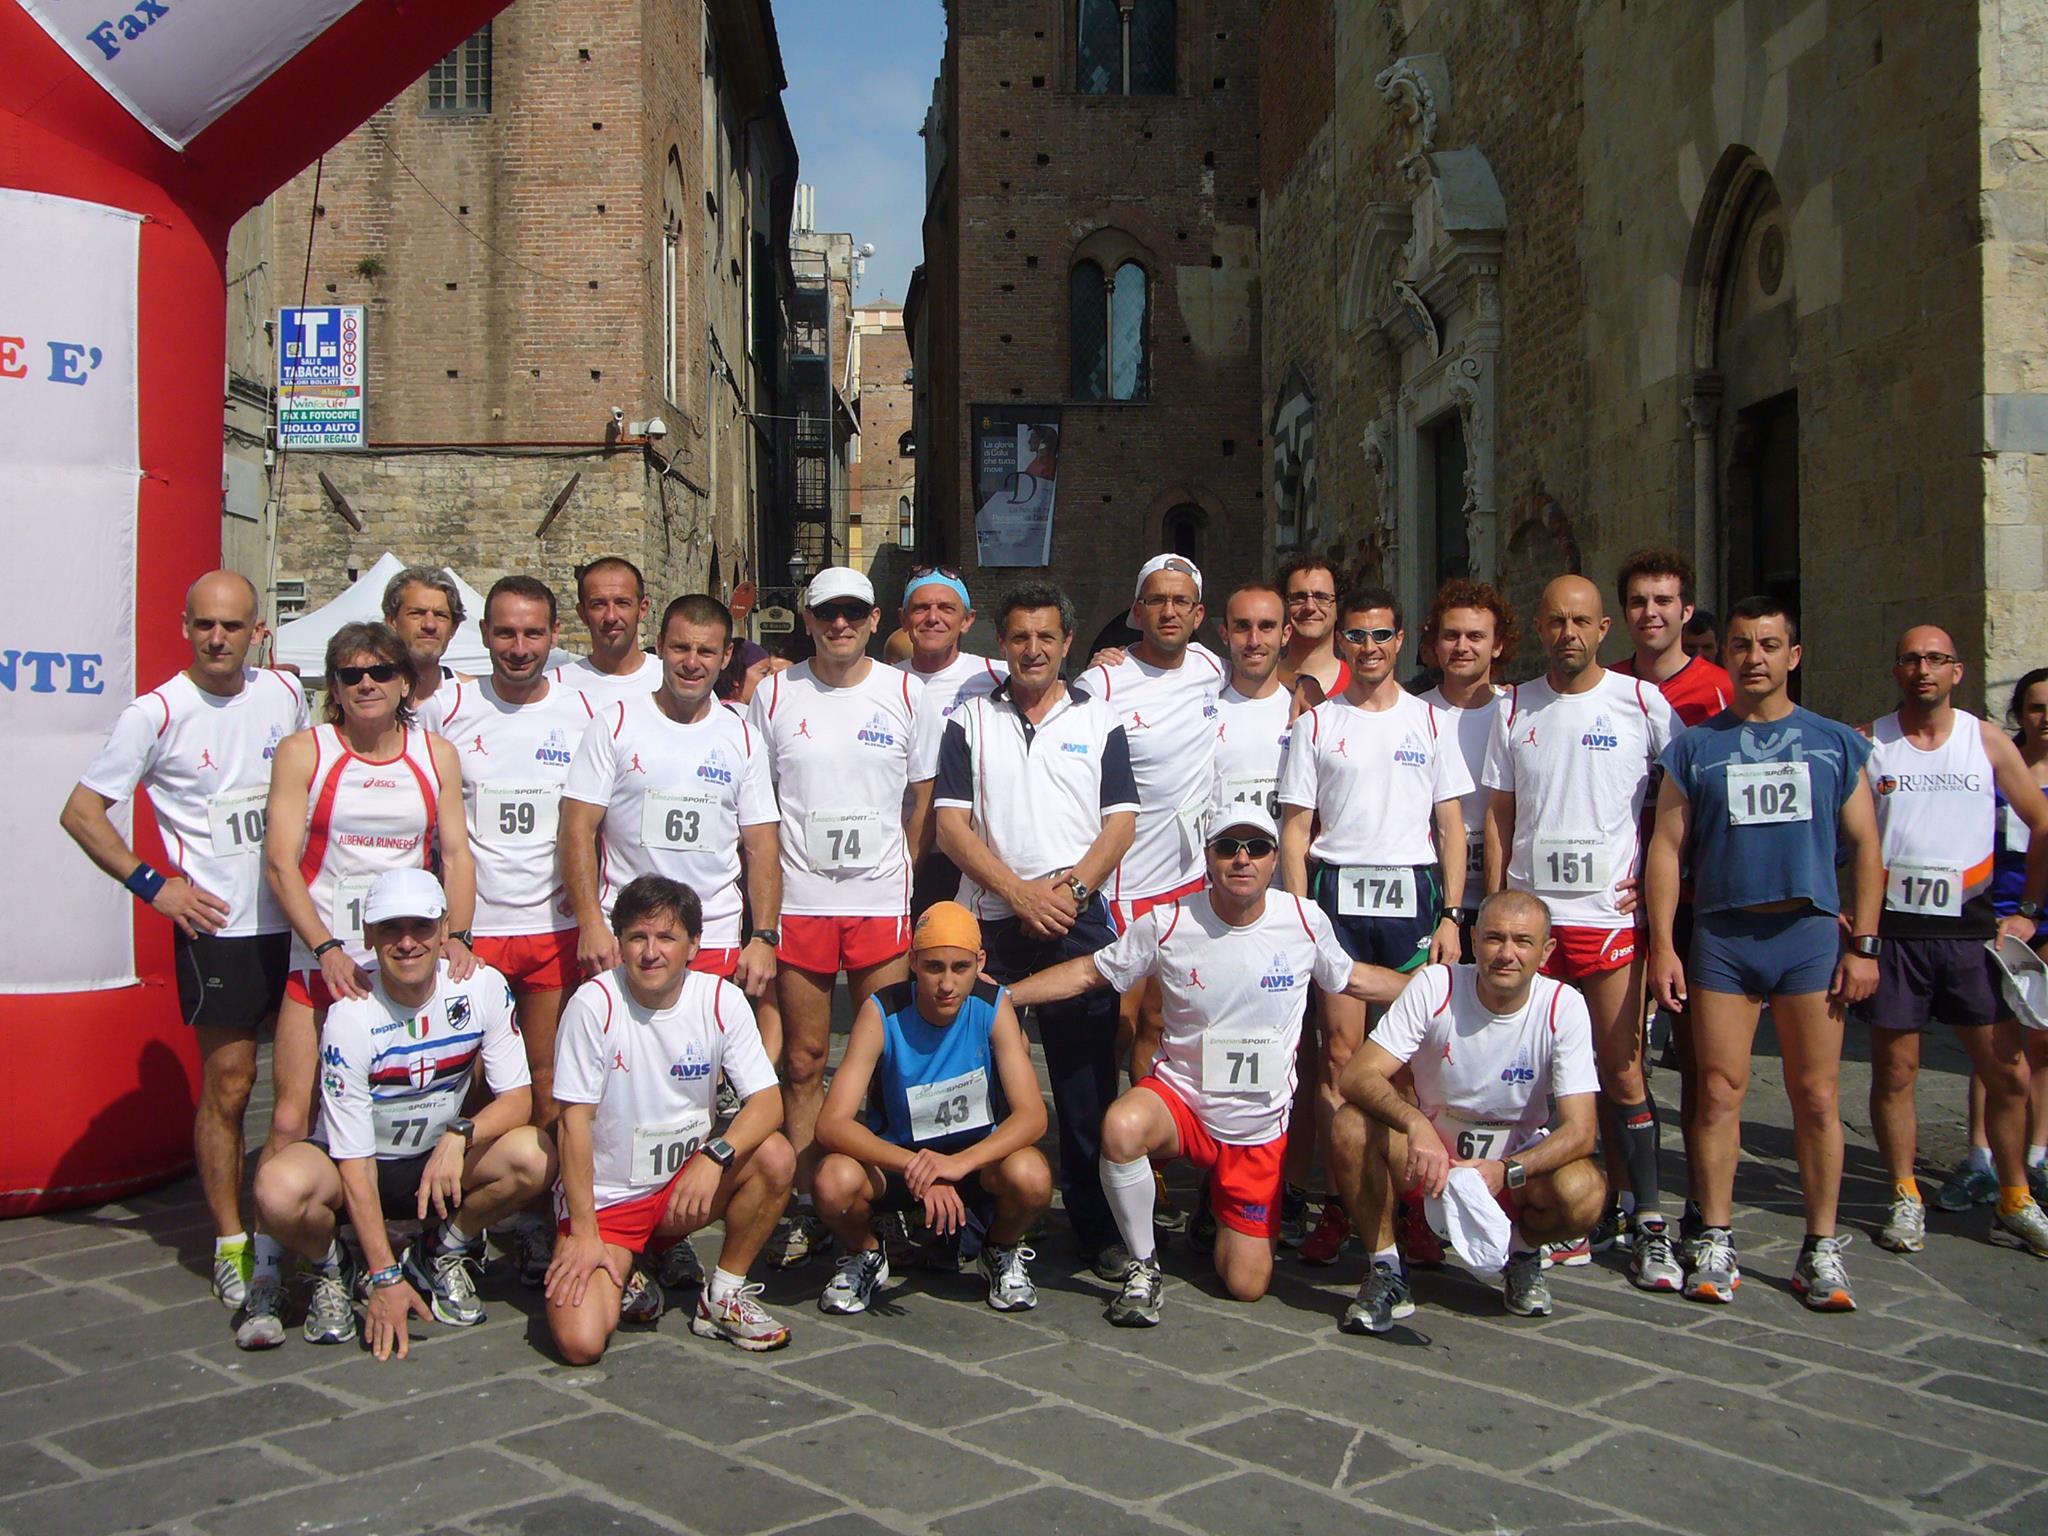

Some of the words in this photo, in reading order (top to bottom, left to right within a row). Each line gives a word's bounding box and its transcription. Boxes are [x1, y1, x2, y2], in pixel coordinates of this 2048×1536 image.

[284, 365, 339, 378] TABACCHI
[300, 357, 316, 366] SALI
[316, 357, 322, 366] E
[282, 411, 299, 420] FAX
[301, 411, 307, 420] &
[309, 410, 357, 420] FOTOCOPIE
[284, 423, 322, 433] BOLLO
[324, 423, 356, 432] AUTO
[323, 434, 357, 444] REGALO
[857, 729, 894, 746] AVIS
[1581, 734, 1618, 749] AVIS
[535, 748, 571, 763] AVIS
[1394, 749, 1426, 765] AVIS
[697, 765, 732, 784] AVIS
[1898, 773, 1980, 792] RUNNING
[1742, 782, 1798, 816] 102
[225, 807, 269, 846] 10
[499, 801, 535, 835] 59
[665, 808, 701, 843] 63
[826, 828, 861, 861] 74
[1546, 851, 1594, 884] 151
[1352, 878, 1404, 910] 174
[1901, 875, 1950, 908] 170
[346, 897, 361, 932] 1
[1260, 975, 1295, 989] AVIS
[670, 1062, 711, 1077] AVIS
[1226, 1051, 1259, 1085] 71
[934, 1094, 970, 1128] 43
[391, 1117, 429, 1148] 77
[1456, 1130, 1494, 1160] 67
